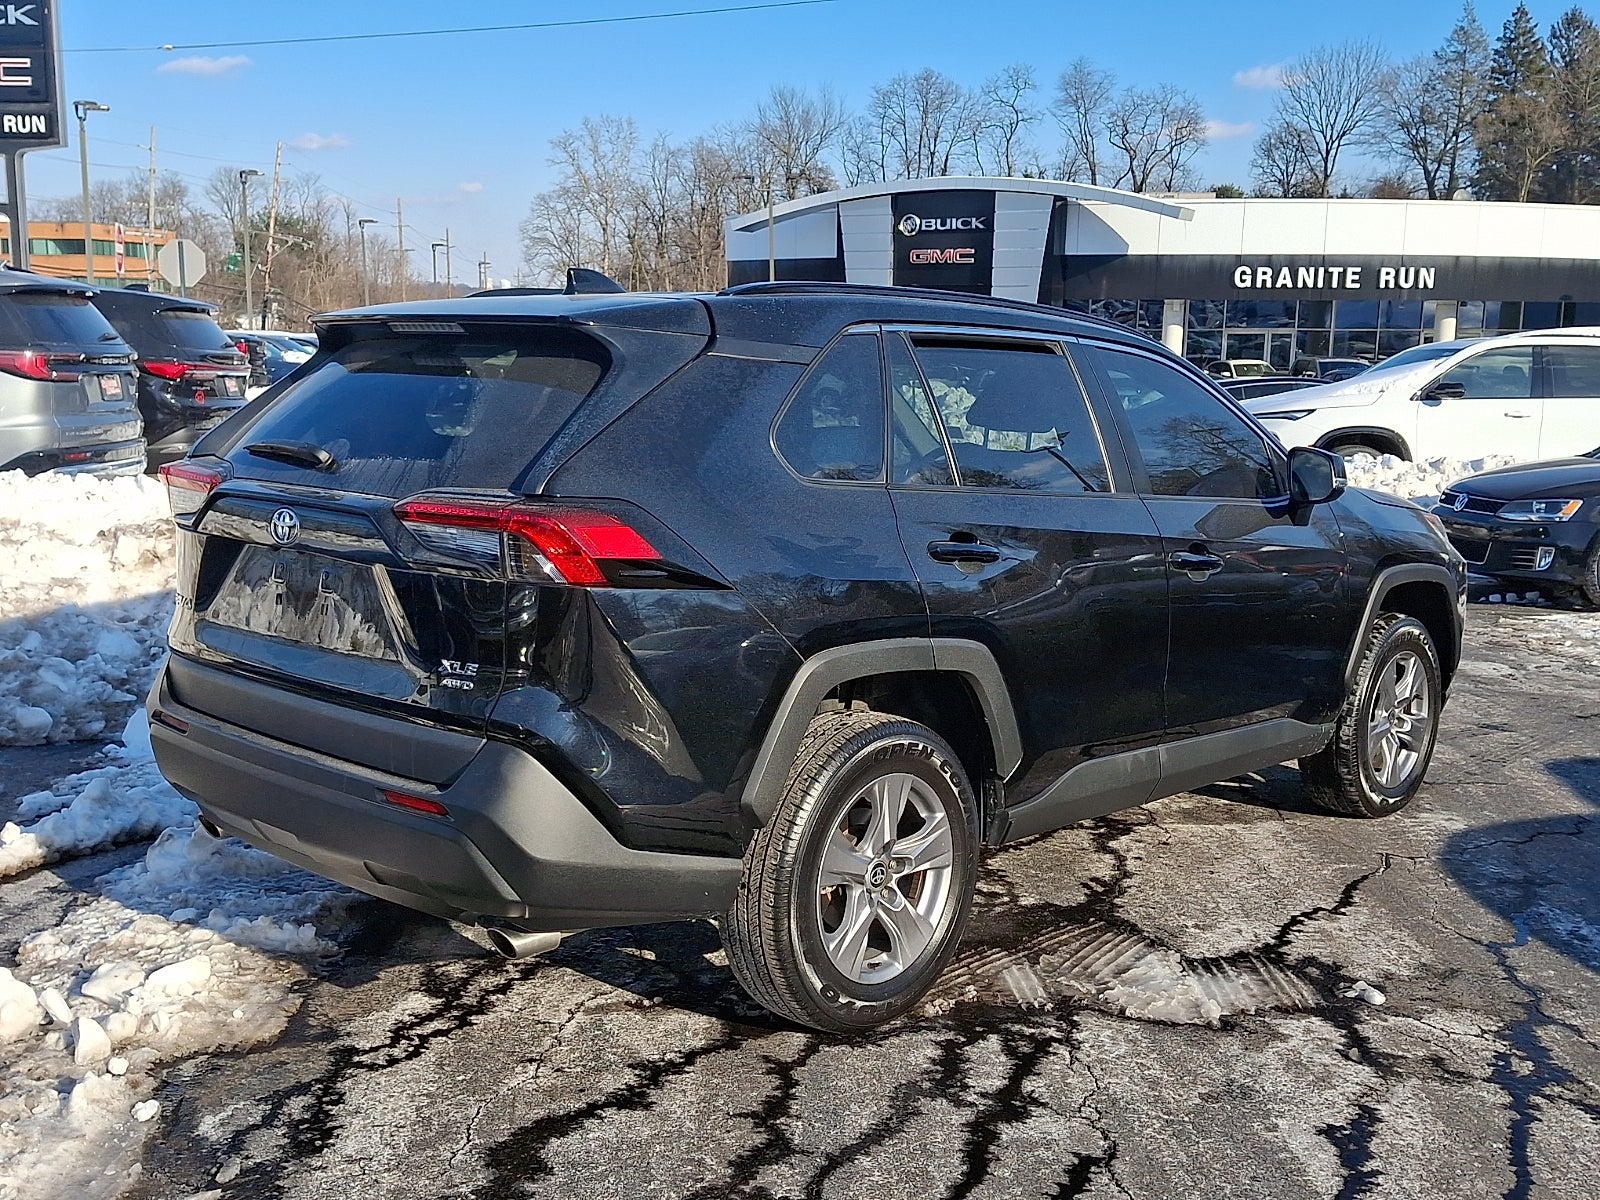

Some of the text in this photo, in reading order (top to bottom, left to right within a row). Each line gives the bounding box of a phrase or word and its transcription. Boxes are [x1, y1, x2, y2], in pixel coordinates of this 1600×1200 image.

[0, 4, 39, 25] K
[3, 114, 46, 133] RUN
[921, 217, 987, 231] BUICK
[910, 248, 975, 264] GMC
[1234, 265, 1436, 290] GRANITE RUN
[438, 659, 479, 676] XLE
